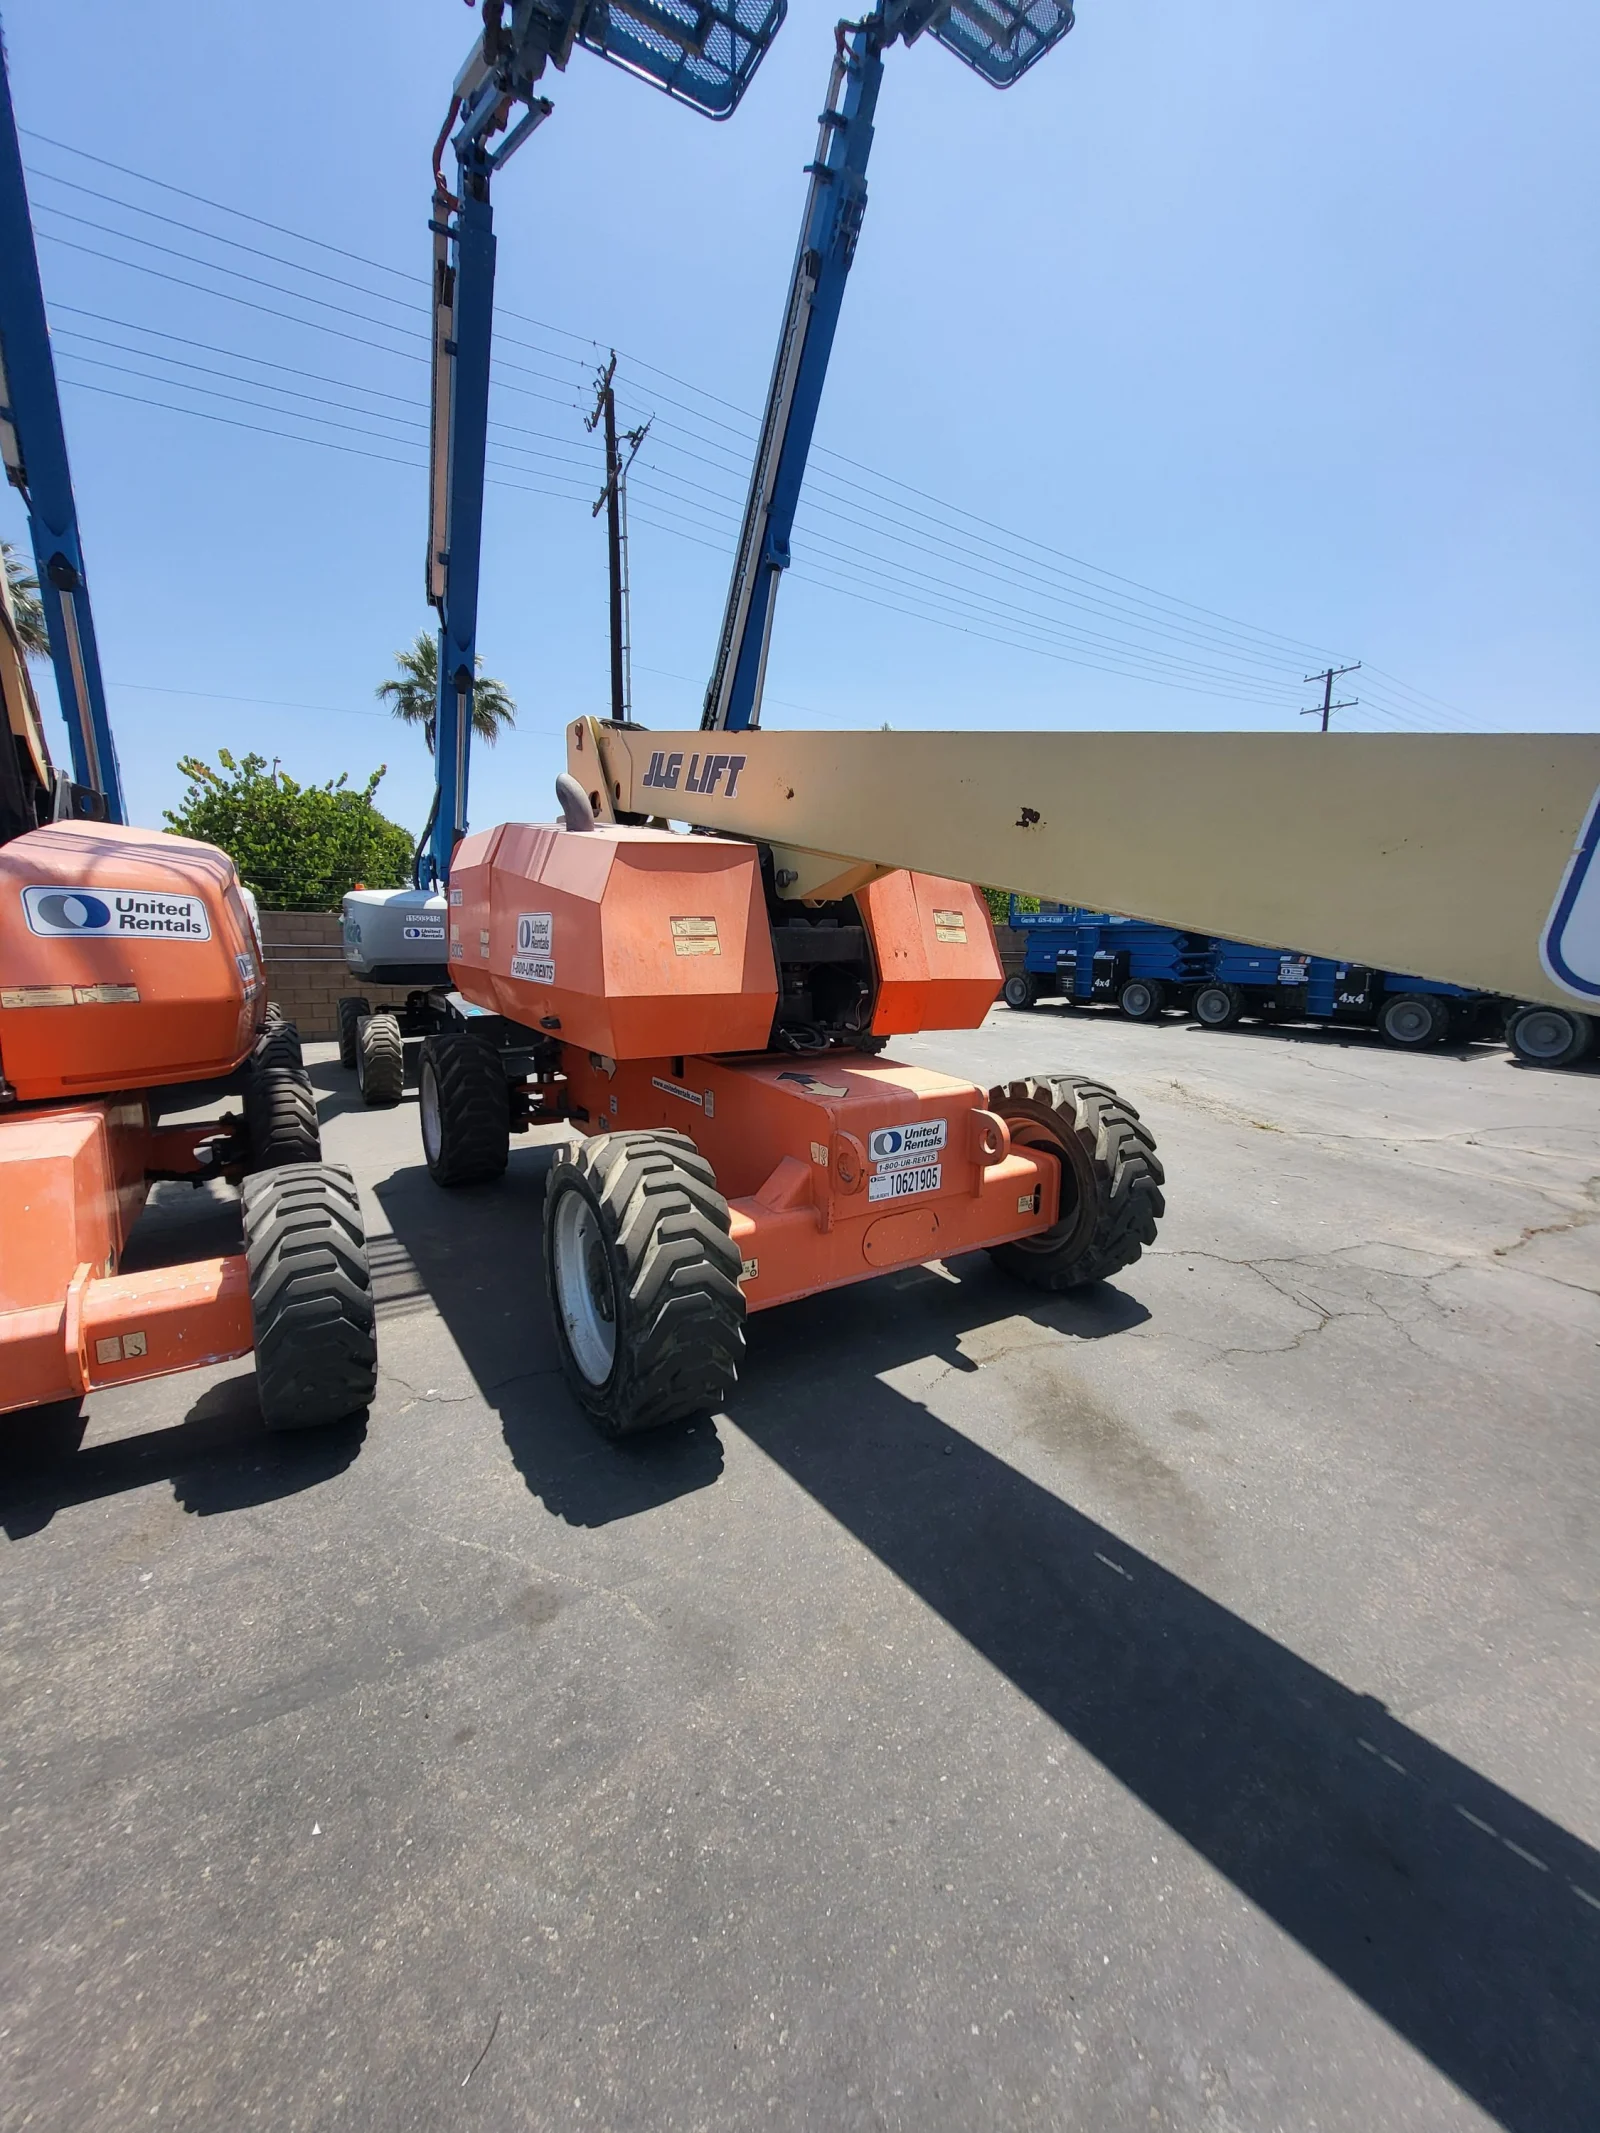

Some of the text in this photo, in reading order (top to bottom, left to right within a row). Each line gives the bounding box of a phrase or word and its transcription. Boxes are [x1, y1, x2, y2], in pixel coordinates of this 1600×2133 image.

[642, 752, 747, 798] JLG LIFT
[116, 897, 192, 917] United
[119, 915, 202, 934] Rentals
[532, 920, 550, 935] United
[531, 936, 550, 950] Rentals
[512, 961, 554, 980] 1-800-UR-RENTS
[1094, 978, 1111, 988] 4x4
[1339, 992, 1365, 1004] 4x4
[653, 1079, 702, 1105] www.unitedrentals.com
[904, 1124, 940, 1140] United
[903, 1136, 942, 1151] Rentals
[879, 1153, 936, 1173] 1-800-UR-RENTS
[890, 1167, 938, 1196] 10621905
